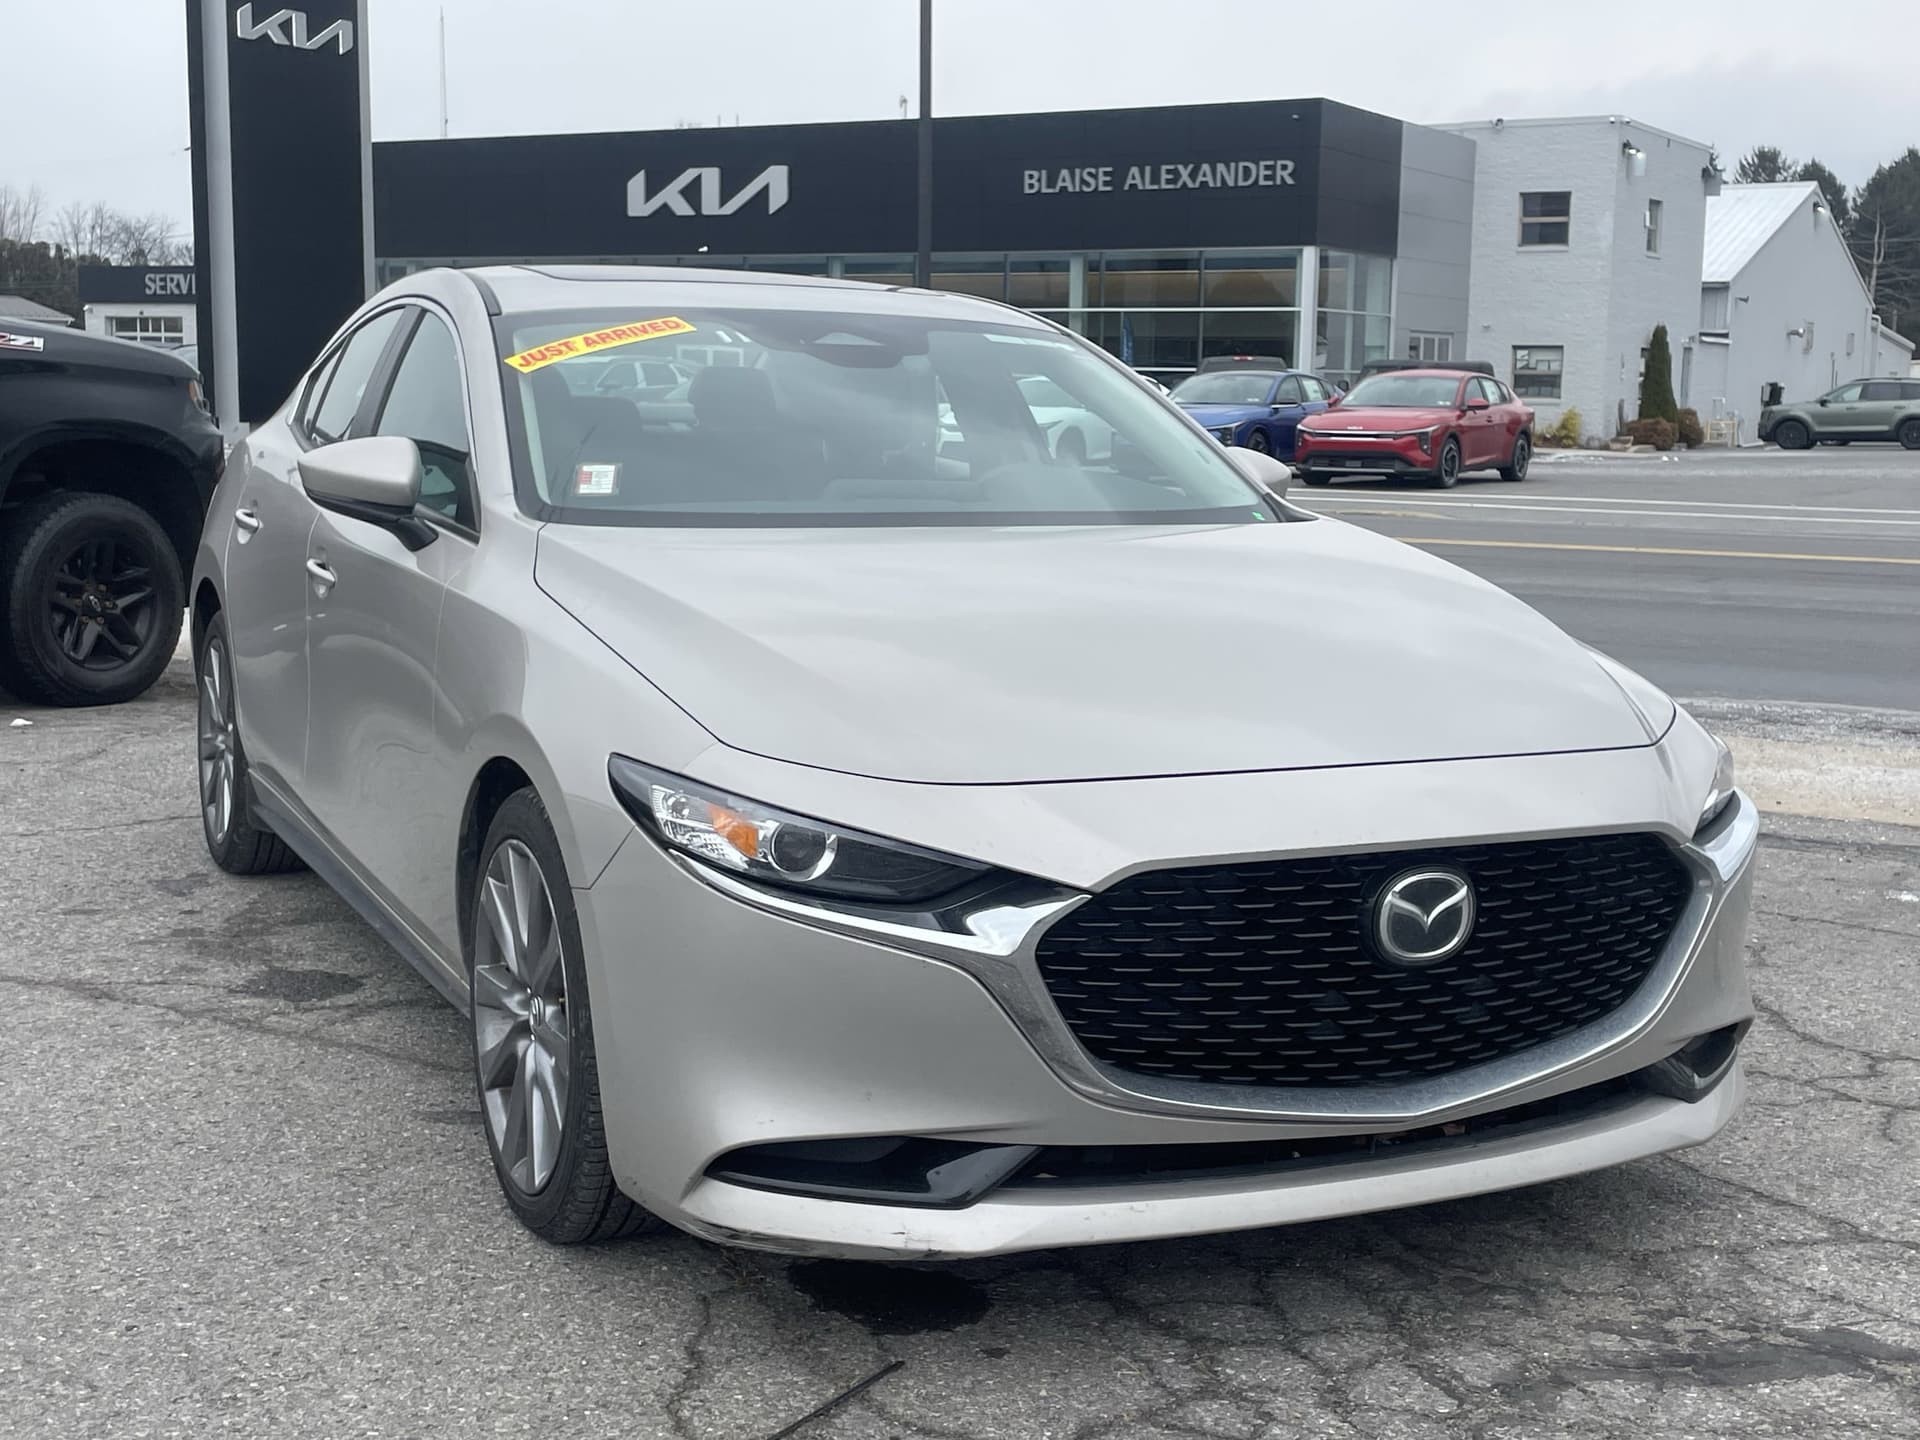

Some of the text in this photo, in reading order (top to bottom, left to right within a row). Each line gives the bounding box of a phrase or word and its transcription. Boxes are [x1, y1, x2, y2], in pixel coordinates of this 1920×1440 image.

[237, 2, 354, 55] KIA
[627, 165, 789, 217] KIA
[1023, 160, 1296, 194] BLAISE ALEXANDER
[145, 273, 196, 295] SERVI
[518, 318, 684, 368] JUST ARRIVED
